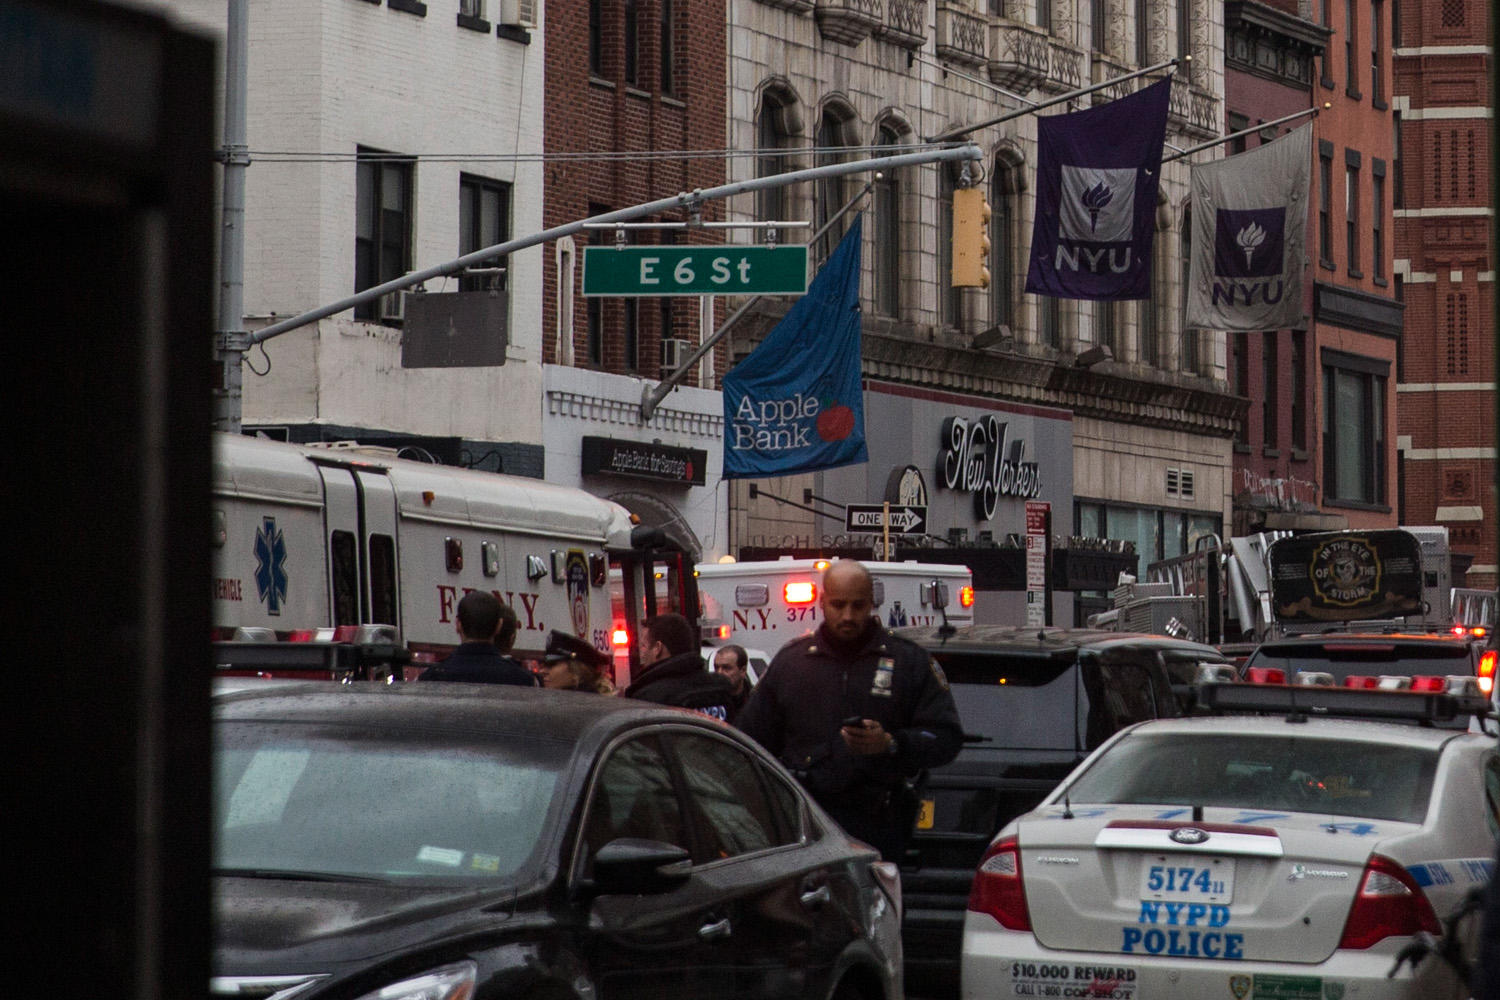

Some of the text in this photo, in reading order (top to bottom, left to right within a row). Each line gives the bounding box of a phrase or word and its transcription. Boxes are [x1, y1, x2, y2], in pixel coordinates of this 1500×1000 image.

[640, 256, 751, 285] E 6 St
[1055, 244, 1131, 273] NYU
[1211, 280, 1284, 306] NYU
[733, 394, 820, 427] Apple
[733, 422, 812, 450] Bank
[611, 447, 633, 472] Apple
[633, 450, 649, 471] Bank
[660, 454, 686, 479] Savings
[945, 415, 986, 492] New
[858, 511, 916, 526] ONE WAY
[1330, 541, 1350, 552] THE
[1315, 567, 1329, 579] OF
[787, 606, 817, 622] 371
[593, 629, 610, 651] 650
[1147, 865, 1212, 894] 5174
[1138, 900, 1232, 928] NYPD
[1121, 927, 1245, 959] POLICE
[1012, 961, 1137, 981] $10,000 REWARD
[1015, 983, 1035, 996] CALL
